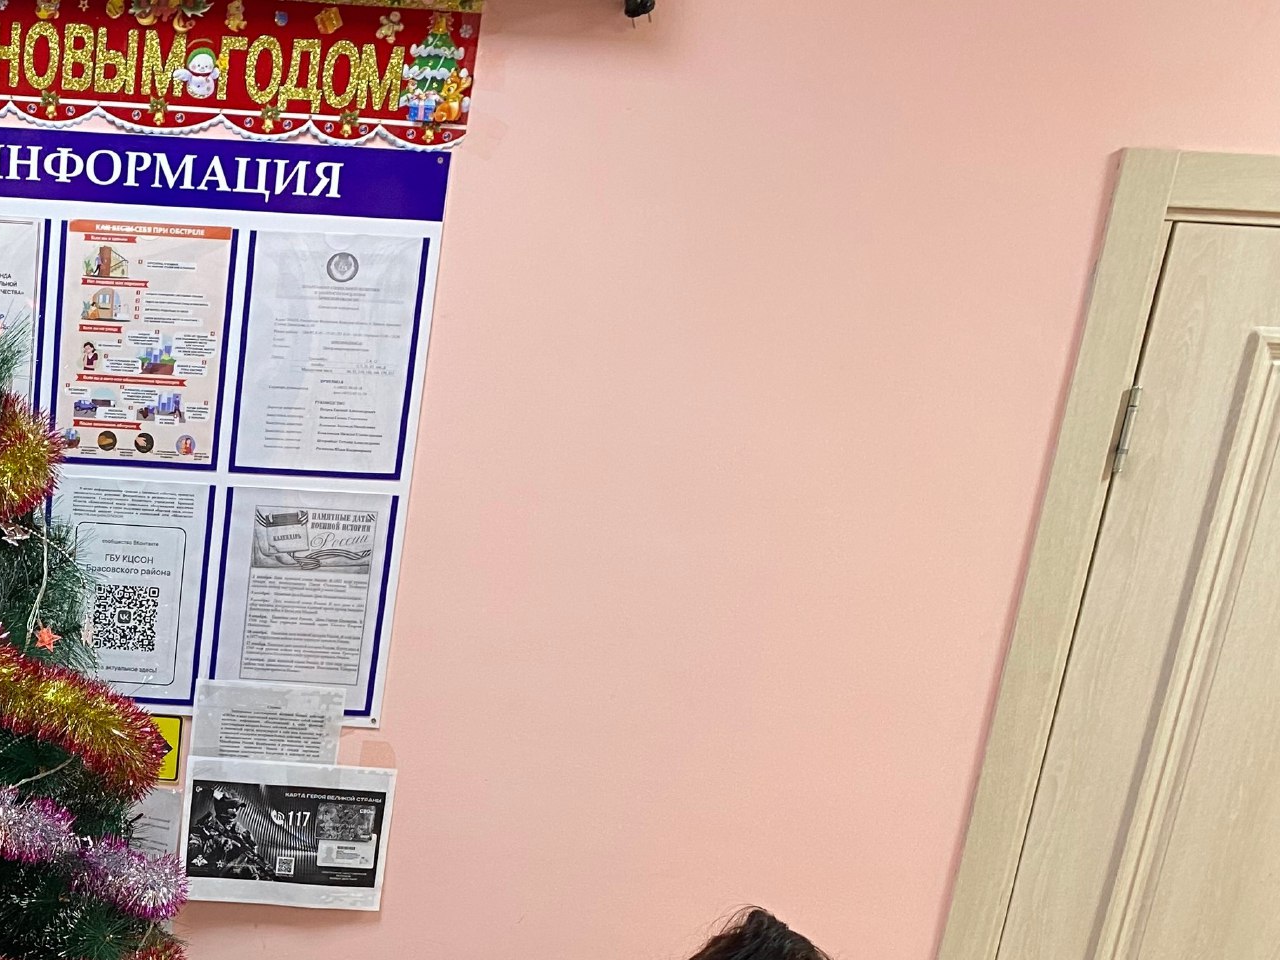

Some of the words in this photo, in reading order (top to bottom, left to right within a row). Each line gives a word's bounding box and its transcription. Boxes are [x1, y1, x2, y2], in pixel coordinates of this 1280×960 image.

[219, 35, 406, 112] ГОДОМ
[169, 228, 205, 236] ОБСТРЕЛЕ
[311, 512, 351, 521] ПАМЯТНЫЕ
[352, 514, 372, 523] ДАТЫ
[310, 522, 340, 531] ВОЕННОЙ
[341, 524, 371, 533] ИСТОРИИ
[105, 553, 121, 562] ГБУ
[122, 555, 154, 565] КЦСОН
[86, 564, 139, 575] Брасовского
[140, 567, 171, 577] района
[105, 665, 138, 673] актуальное
[326, 794, 356, 802] ВЕЛИКОЙ
[288, 810, 311, 827] 117
